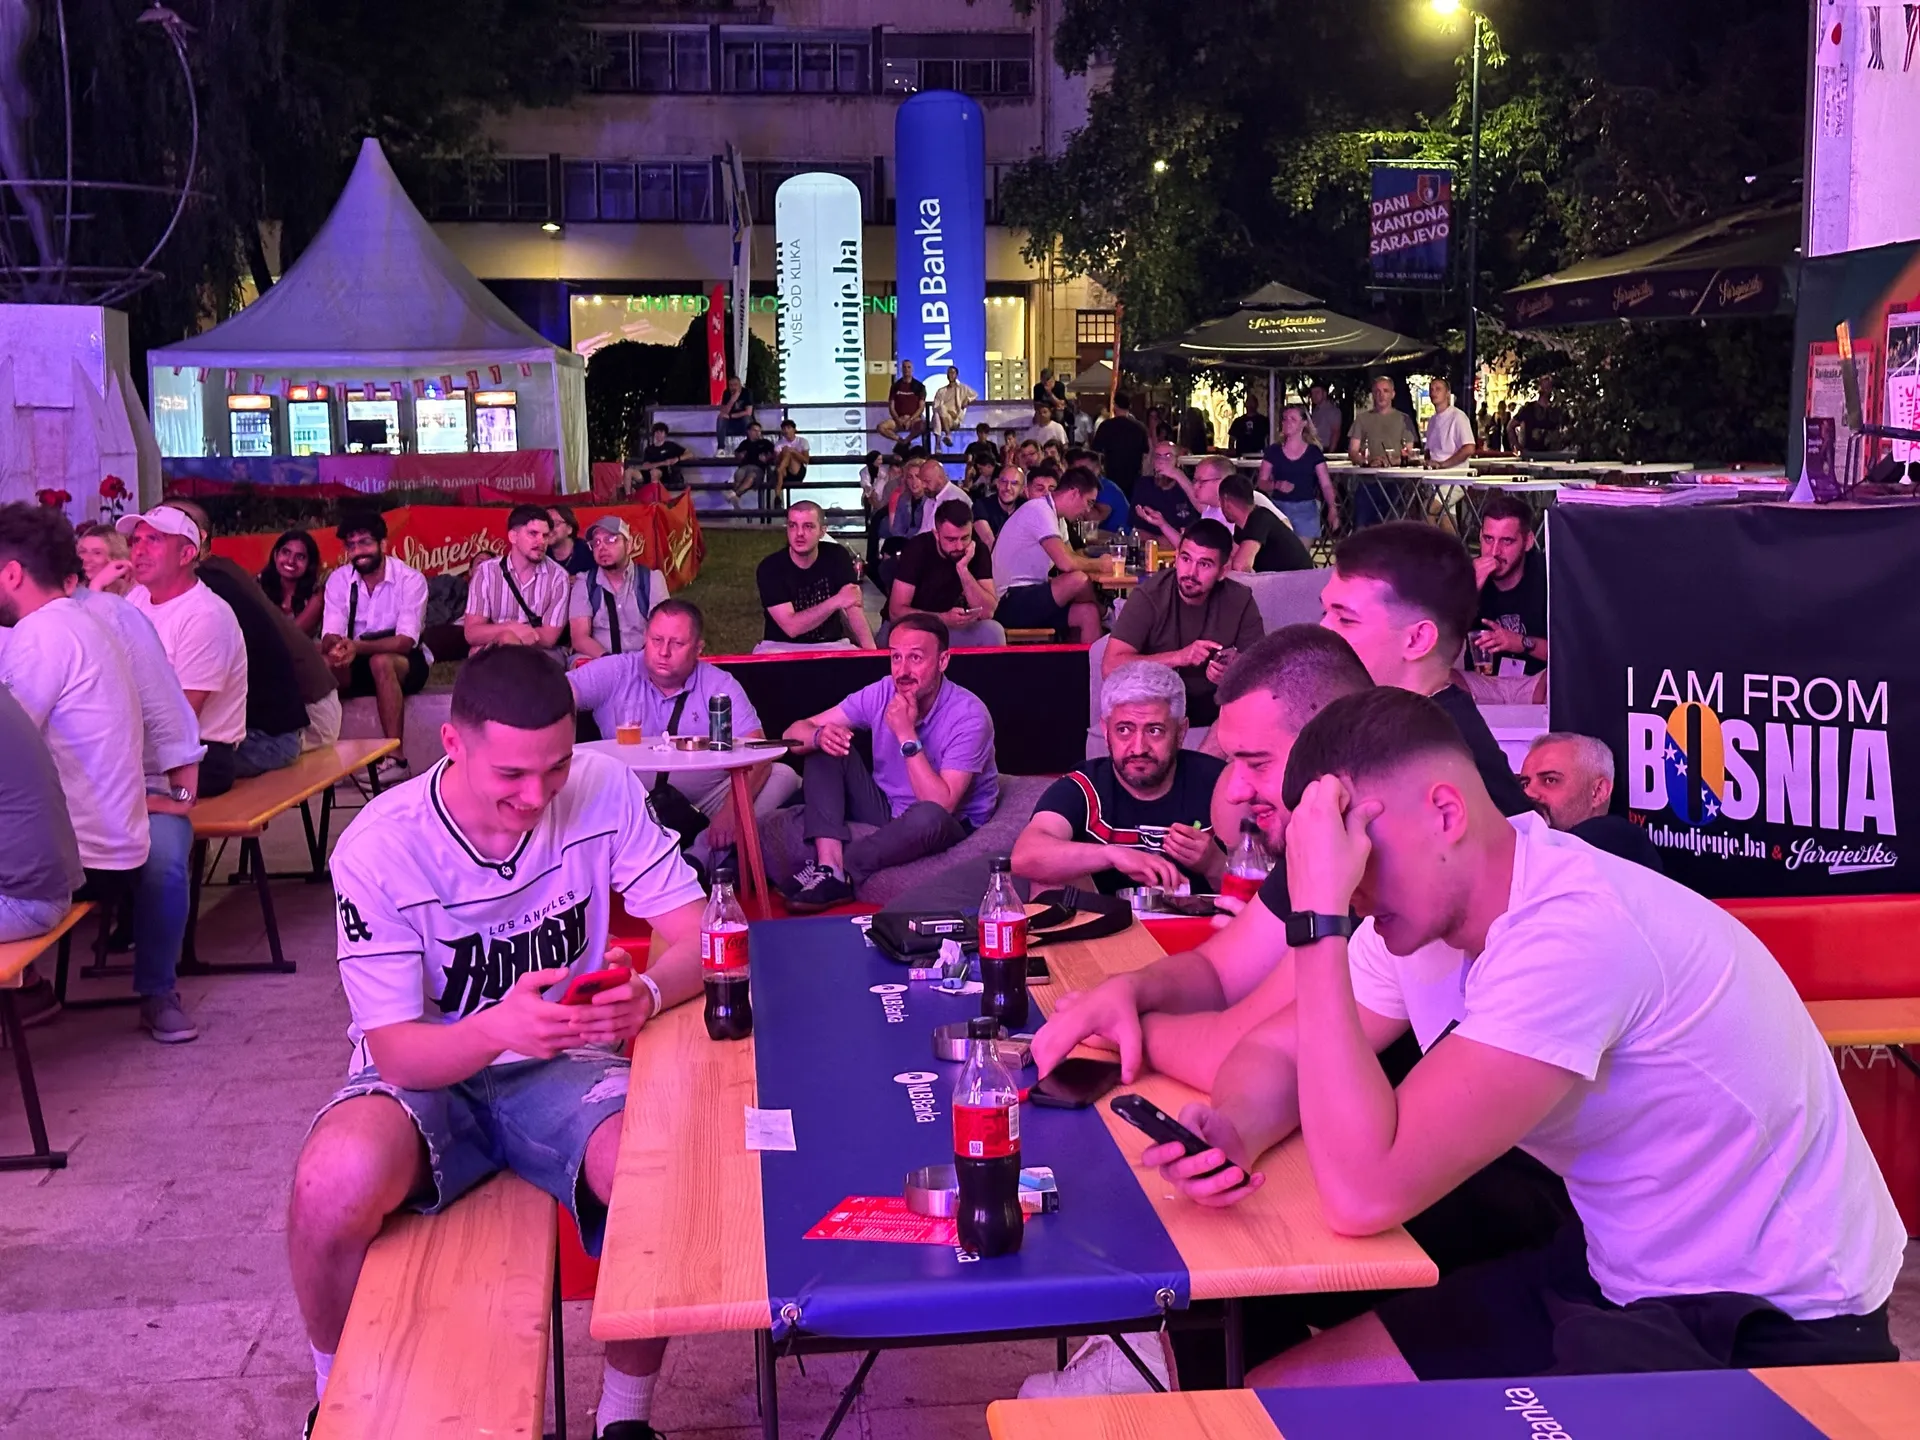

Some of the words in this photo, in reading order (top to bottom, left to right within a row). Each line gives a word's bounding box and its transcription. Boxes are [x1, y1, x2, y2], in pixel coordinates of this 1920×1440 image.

[1371, 205, 1449, 235] KANTONA
[1372, 194, 1410, 216] DANI
[914, 198, 947, 295] Banka
[1370, 223, 1449, 254] SARAJEVO
[790, 239, 801, 279] KLIKA
[628, 294, 710, 313] UNITED
[791, 284, 802, 305] OD
[792, 313, 803, 345] VIŠE
[921, 300, 954, 367] NLB
[496, 473, 536, 491] zgrabi
[1627, 666, 1634, 707] I
[1651, 669, 1724, 714] AM
[1743, 673, 1889, 725] FROM
[1627, 701, 1897, 836] BOSNIA
[1645, 822, 1766, 860] lobodjenje.ba
[1785, 837, 1899, 875] Sarajevsko
[489, 919, 516, 936] LOS
[906, 1083, 933, 1100] NLB
[910, 1099, 941, 1123] Banka
